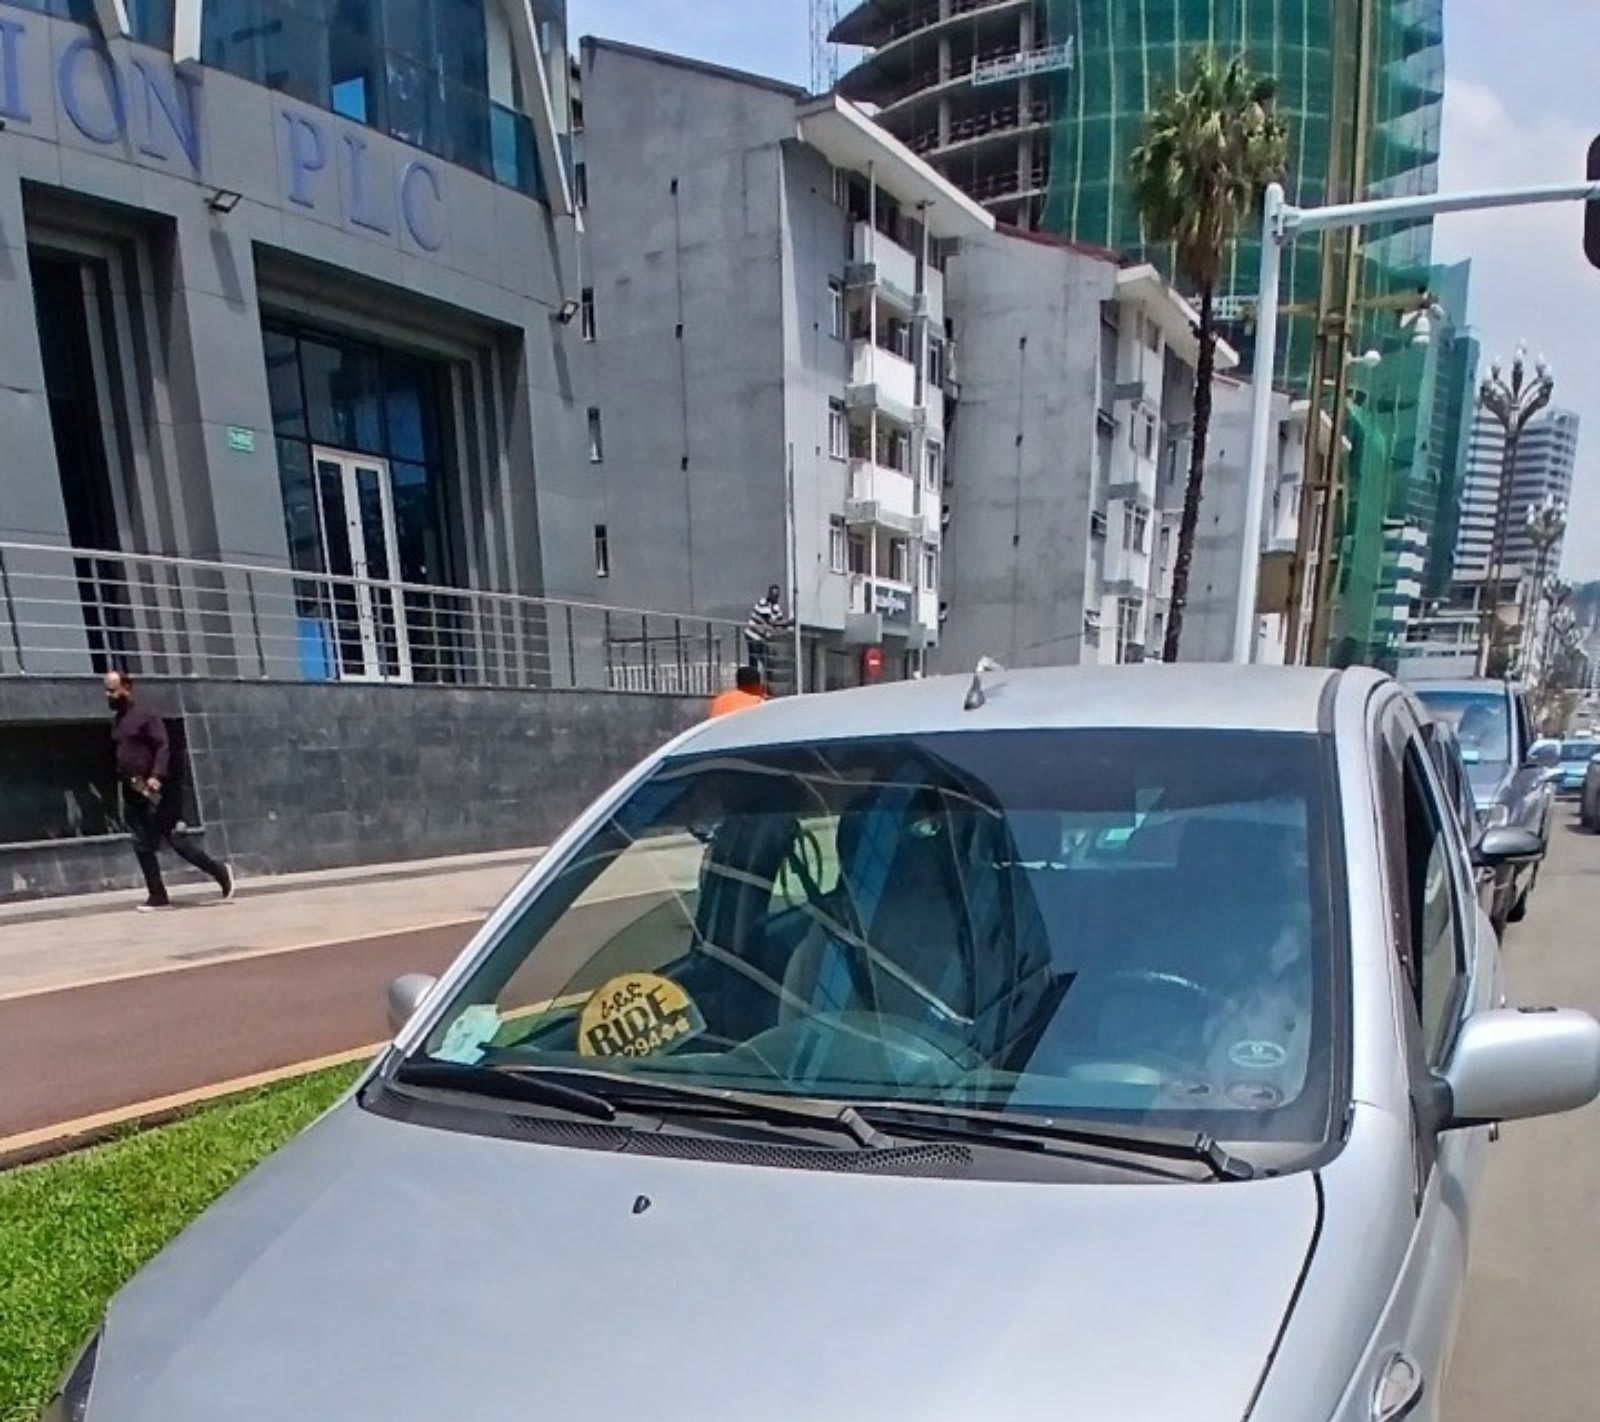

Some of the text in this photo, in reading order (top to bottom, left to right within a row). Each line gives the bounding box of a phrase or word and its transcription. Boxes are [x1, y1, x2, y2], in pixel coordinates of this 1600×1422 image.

[281, 110, 447, 253] PLC
[586, 984, 682, 1056] RIDE
[613, 1028, 663, 1057] 294
